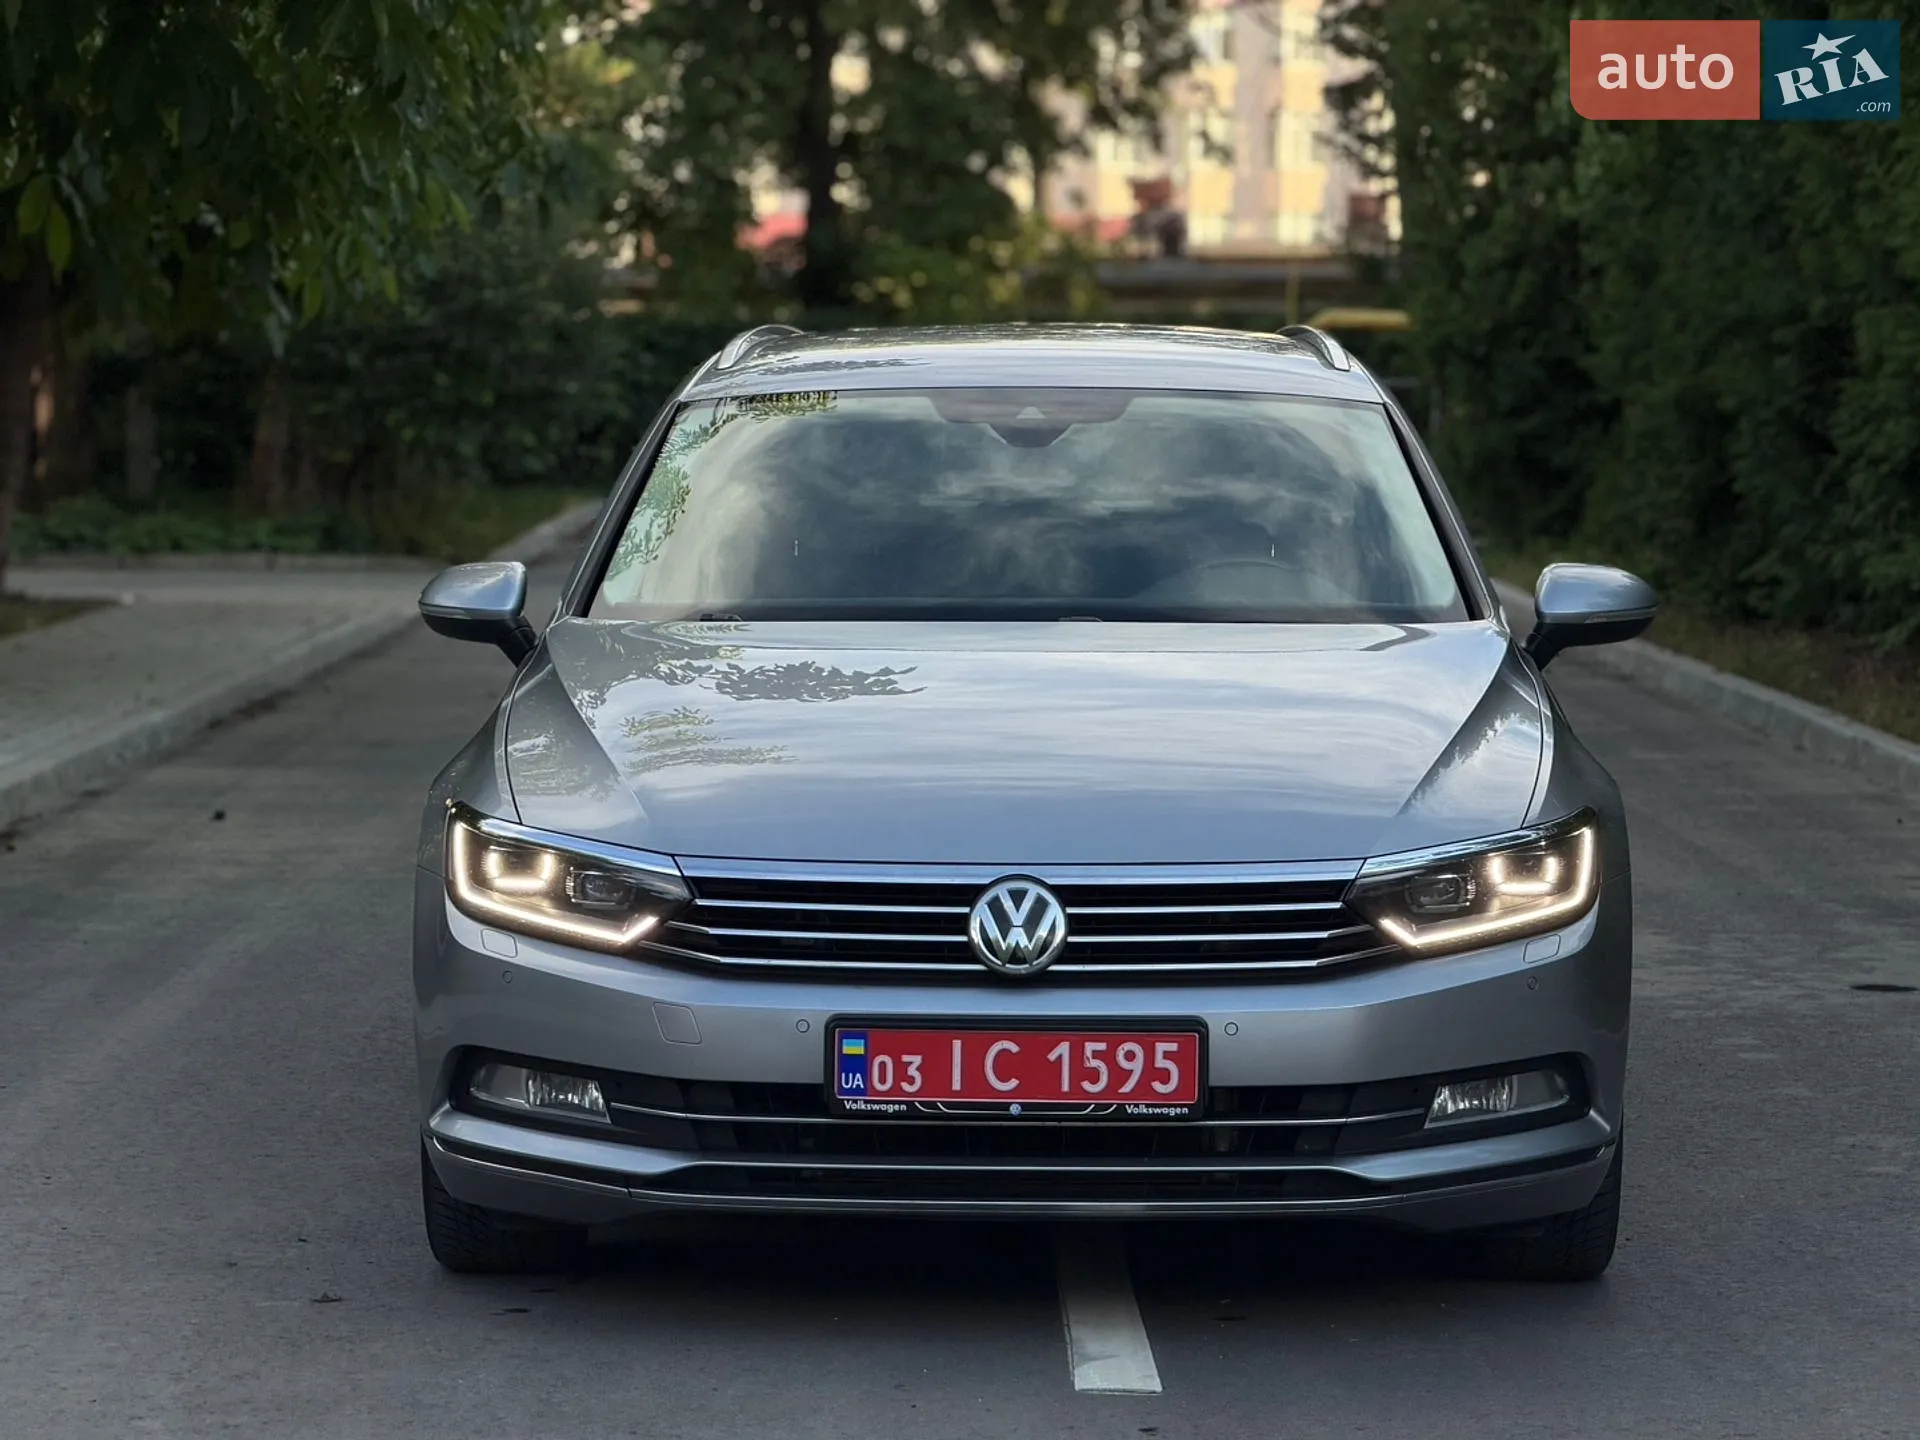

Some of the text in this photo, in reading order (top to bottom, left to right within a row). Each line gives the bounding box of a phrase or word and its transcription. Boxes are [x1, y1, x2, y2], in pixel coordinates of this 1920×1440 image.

[871, 1055, 922, 1093] 03
[1046, 1041, 1180, 1094] 1595
[841, 1073, 864, 1089] UA
[844, 1101, 907, 1113] Volkswagen
[1125, 1104, 1189, 1116] Volkswagen
